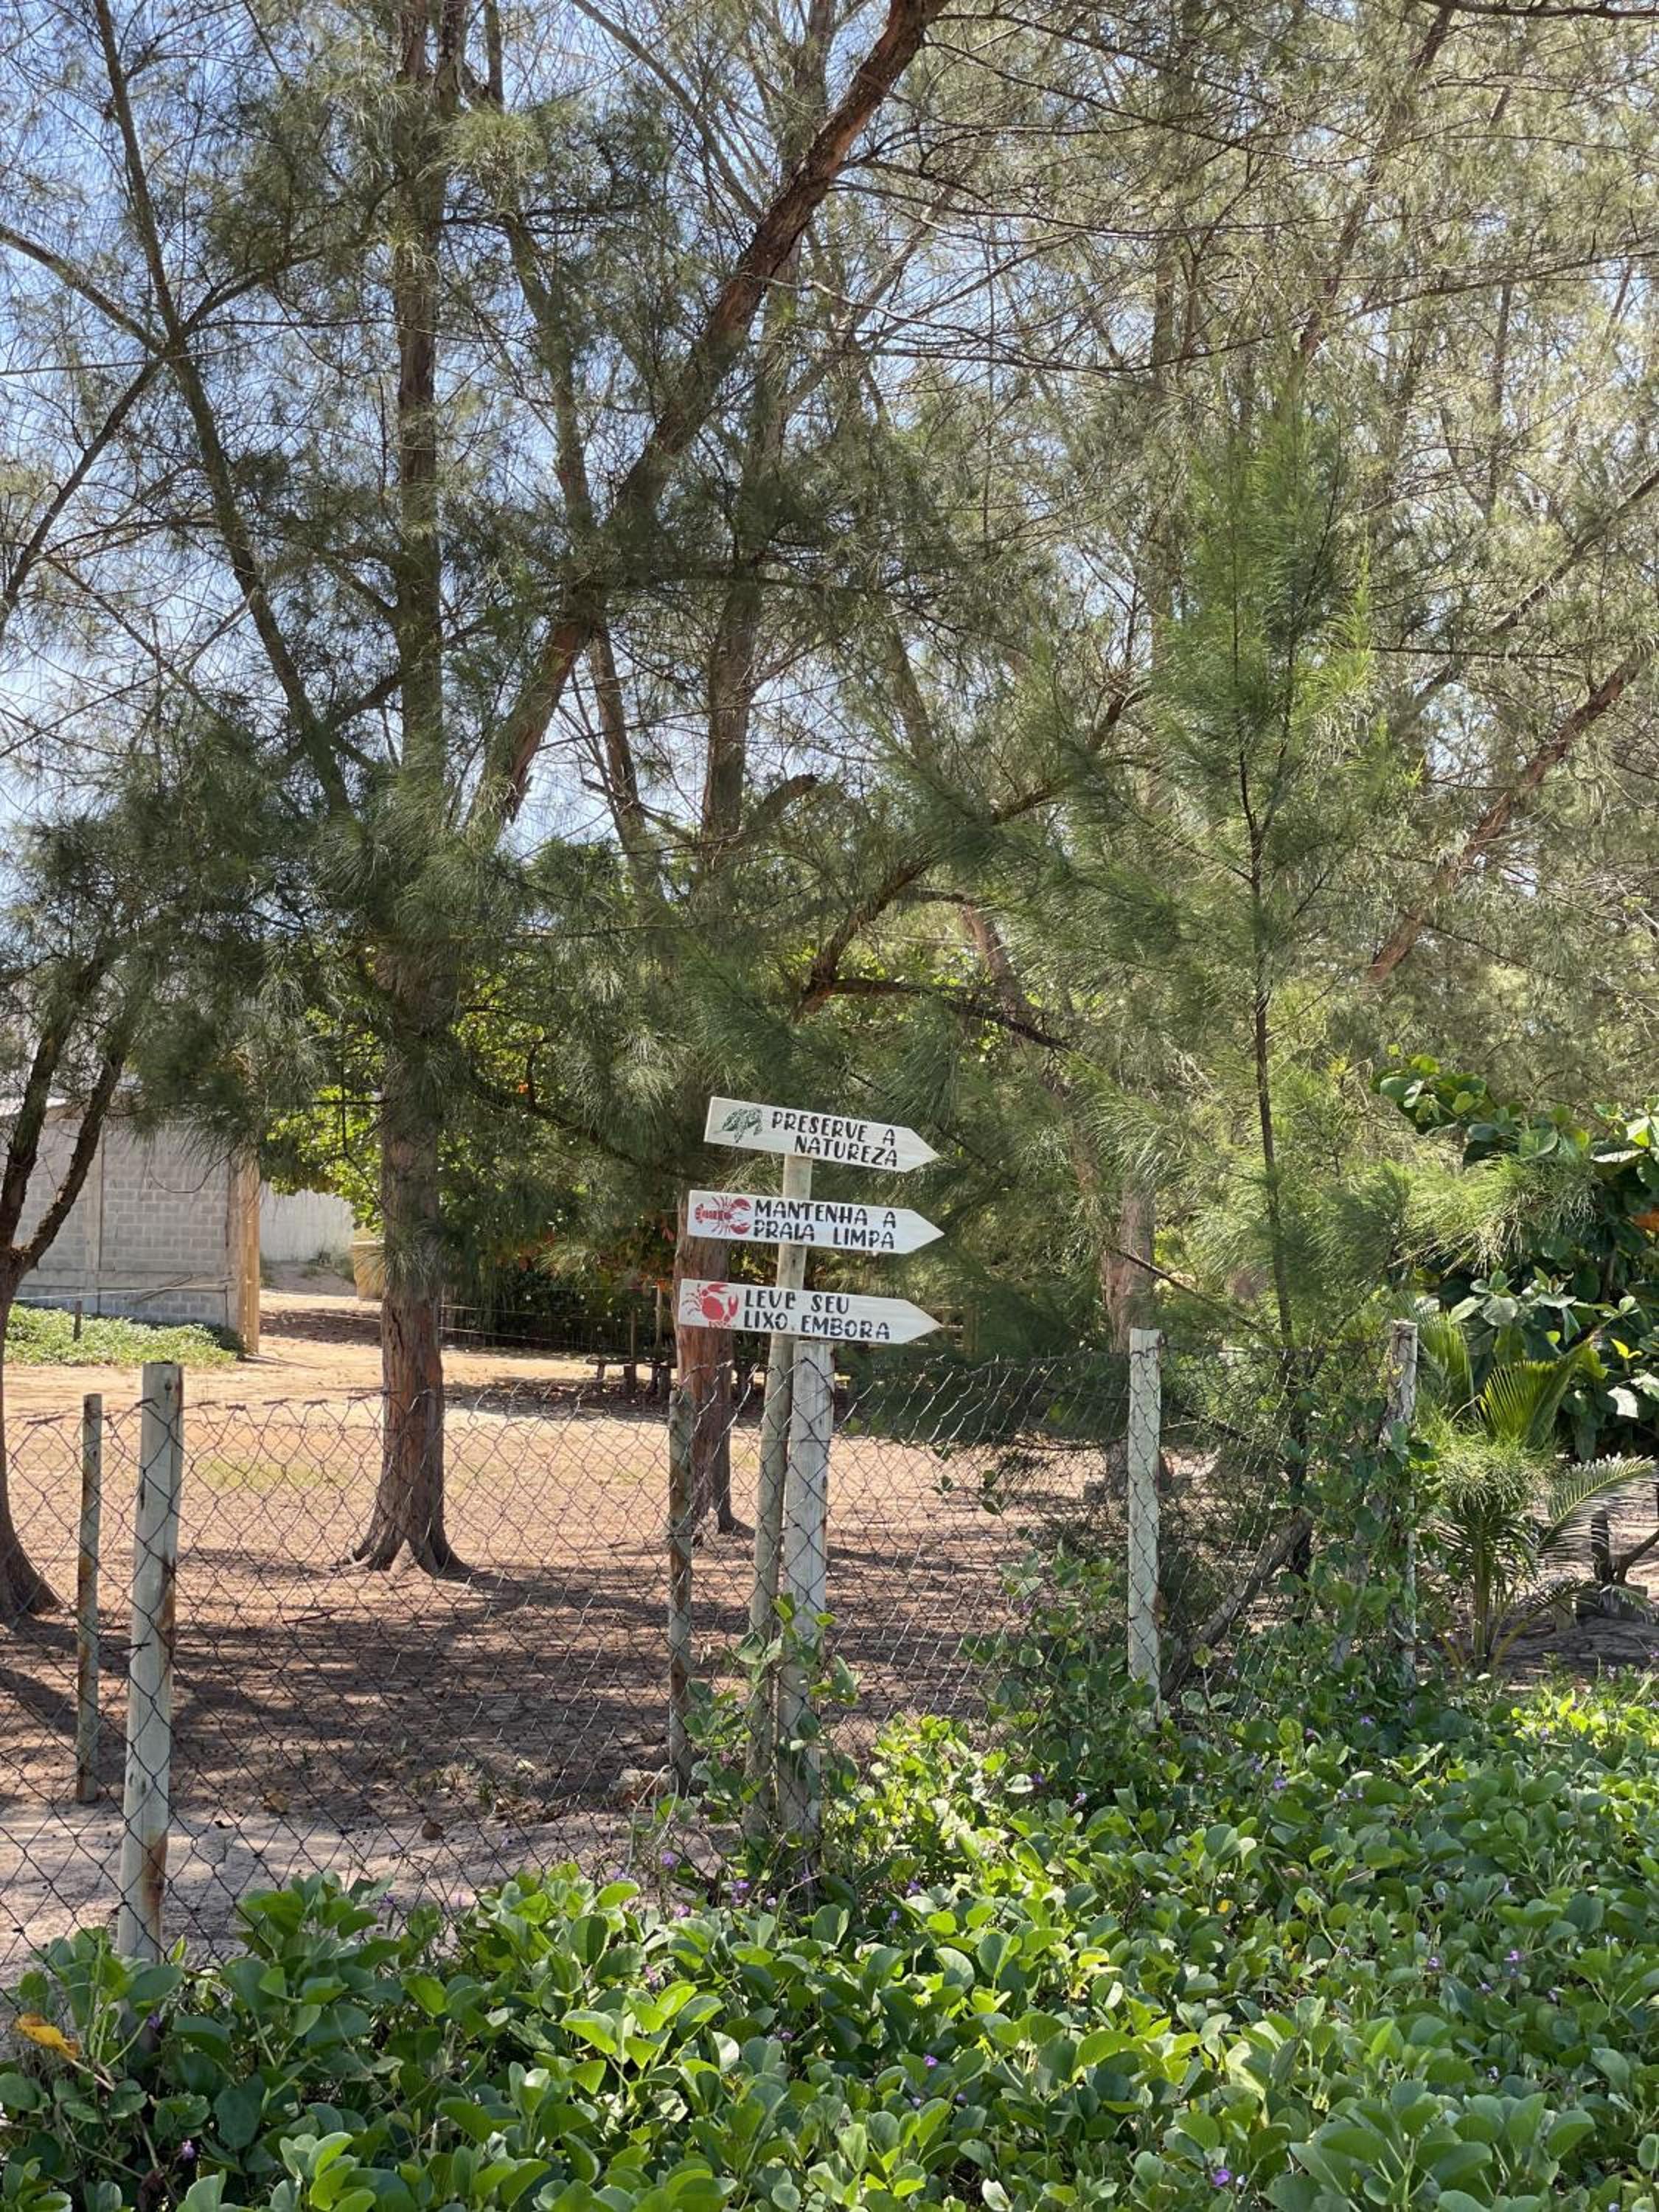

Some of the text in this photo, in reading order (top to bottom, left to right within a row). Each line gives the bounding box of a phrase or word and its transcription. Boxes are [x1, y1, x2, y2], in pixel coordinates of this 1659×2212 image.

[771, 1111, 895, 1146] PRESERVE A
[794, 1135, 897, 1167] NATUREZA
[754, 1200, 896, 1228] MANTENHA A
[754, 1220, 894, 1249] PRAIA LIMPA
[745, 1290, 849, 1315] LEVE SEU
[744, 1310, 891, 1340] LIXO EMBORA
